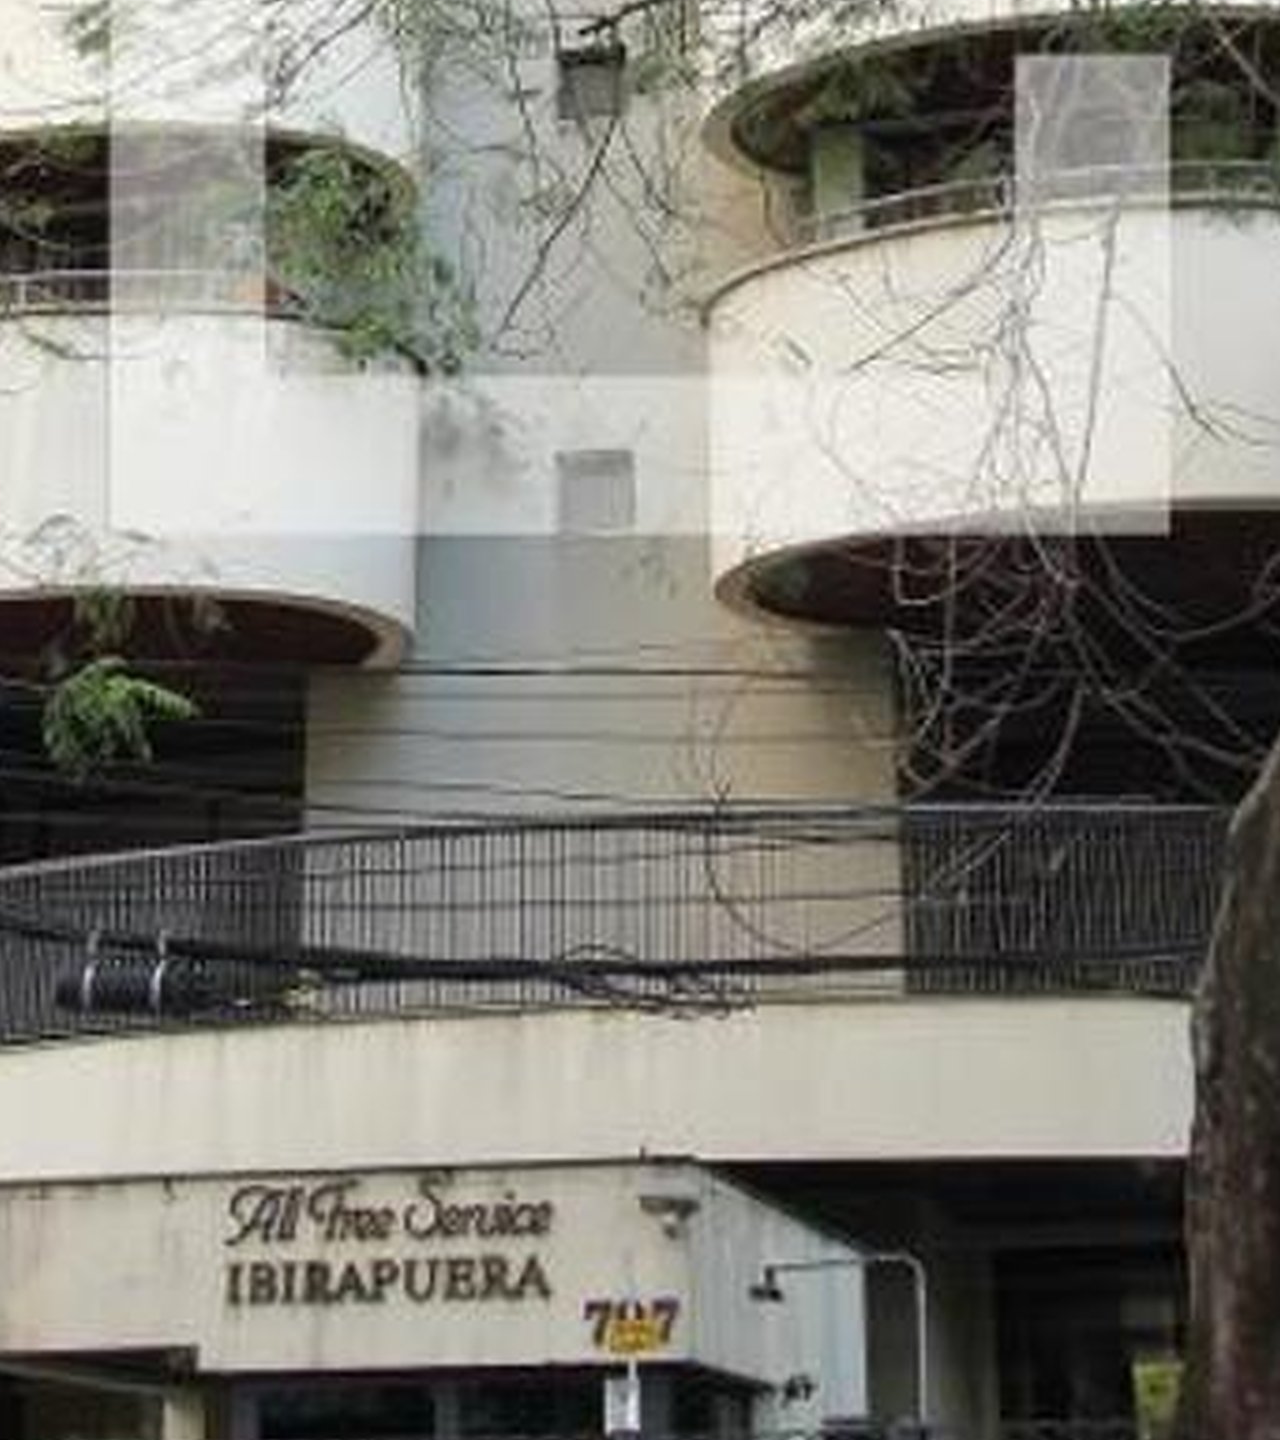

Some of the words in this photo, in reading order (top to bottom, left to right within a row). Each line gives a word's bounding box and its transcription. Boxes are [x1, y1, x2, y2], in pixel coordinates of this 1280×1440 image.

[224, 1184, 304, 1247] All
[308, 1178, 396, 1242] Free
[404, 1169, 553, 1239] Service
[226, 1254, 552, 1306] IBIRAPUERA
